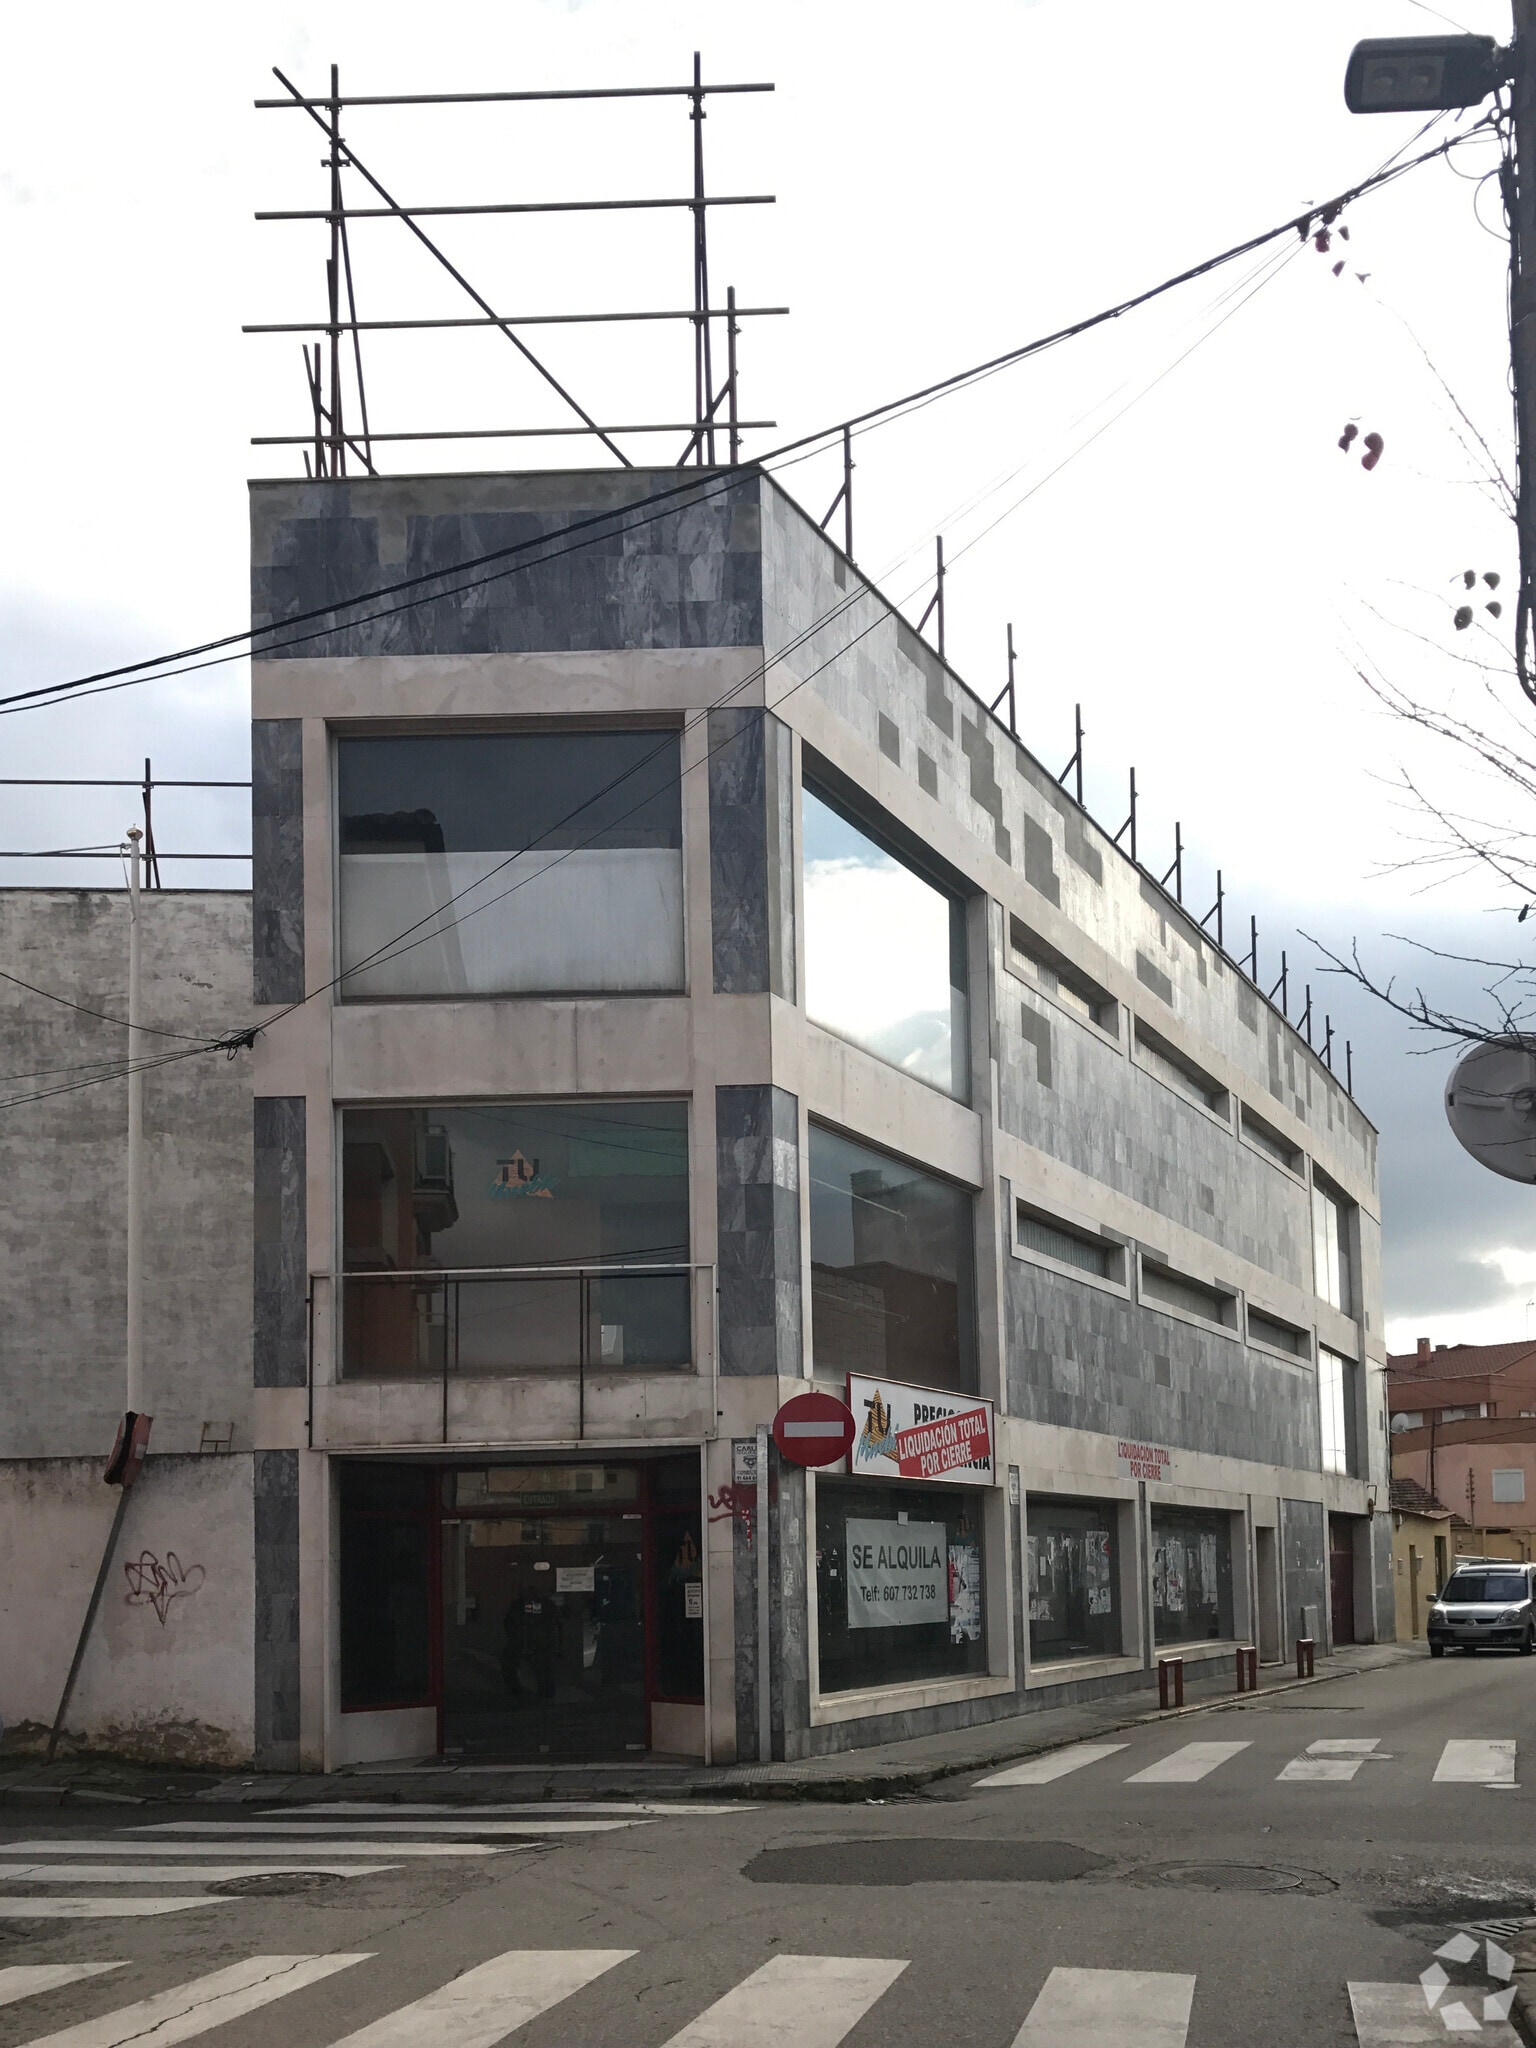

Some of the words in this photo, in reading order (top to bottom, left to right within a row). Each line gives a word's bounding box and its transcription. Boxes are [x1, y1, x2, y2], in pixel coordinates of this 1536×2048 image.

[863, 1399, 891, 1436] TU
[899, 1420, 958, 1461] LIQUIDACIÓN
[958, 1414, 986, 1439] TOTAL
[921, 1453, 941, 1477] POR
[941, 1441, 973, 1469] CIERRE
[1130, 1461, 1142, 1478] POR
[1143, 1463, 1161, 1480] CIERRE
[1154, 1448, 1170, 1466] TOTAL
[852, 1544, 874, 1570] SE
[877, 1545, 942, 1571] ALQUILA
[860, 1586, 880, 1602] Telf:
[883, 1585, 900, 1602] 607
[902, 1585, 918, 1601] 732
[920, 1584, 936, 1600] 738
